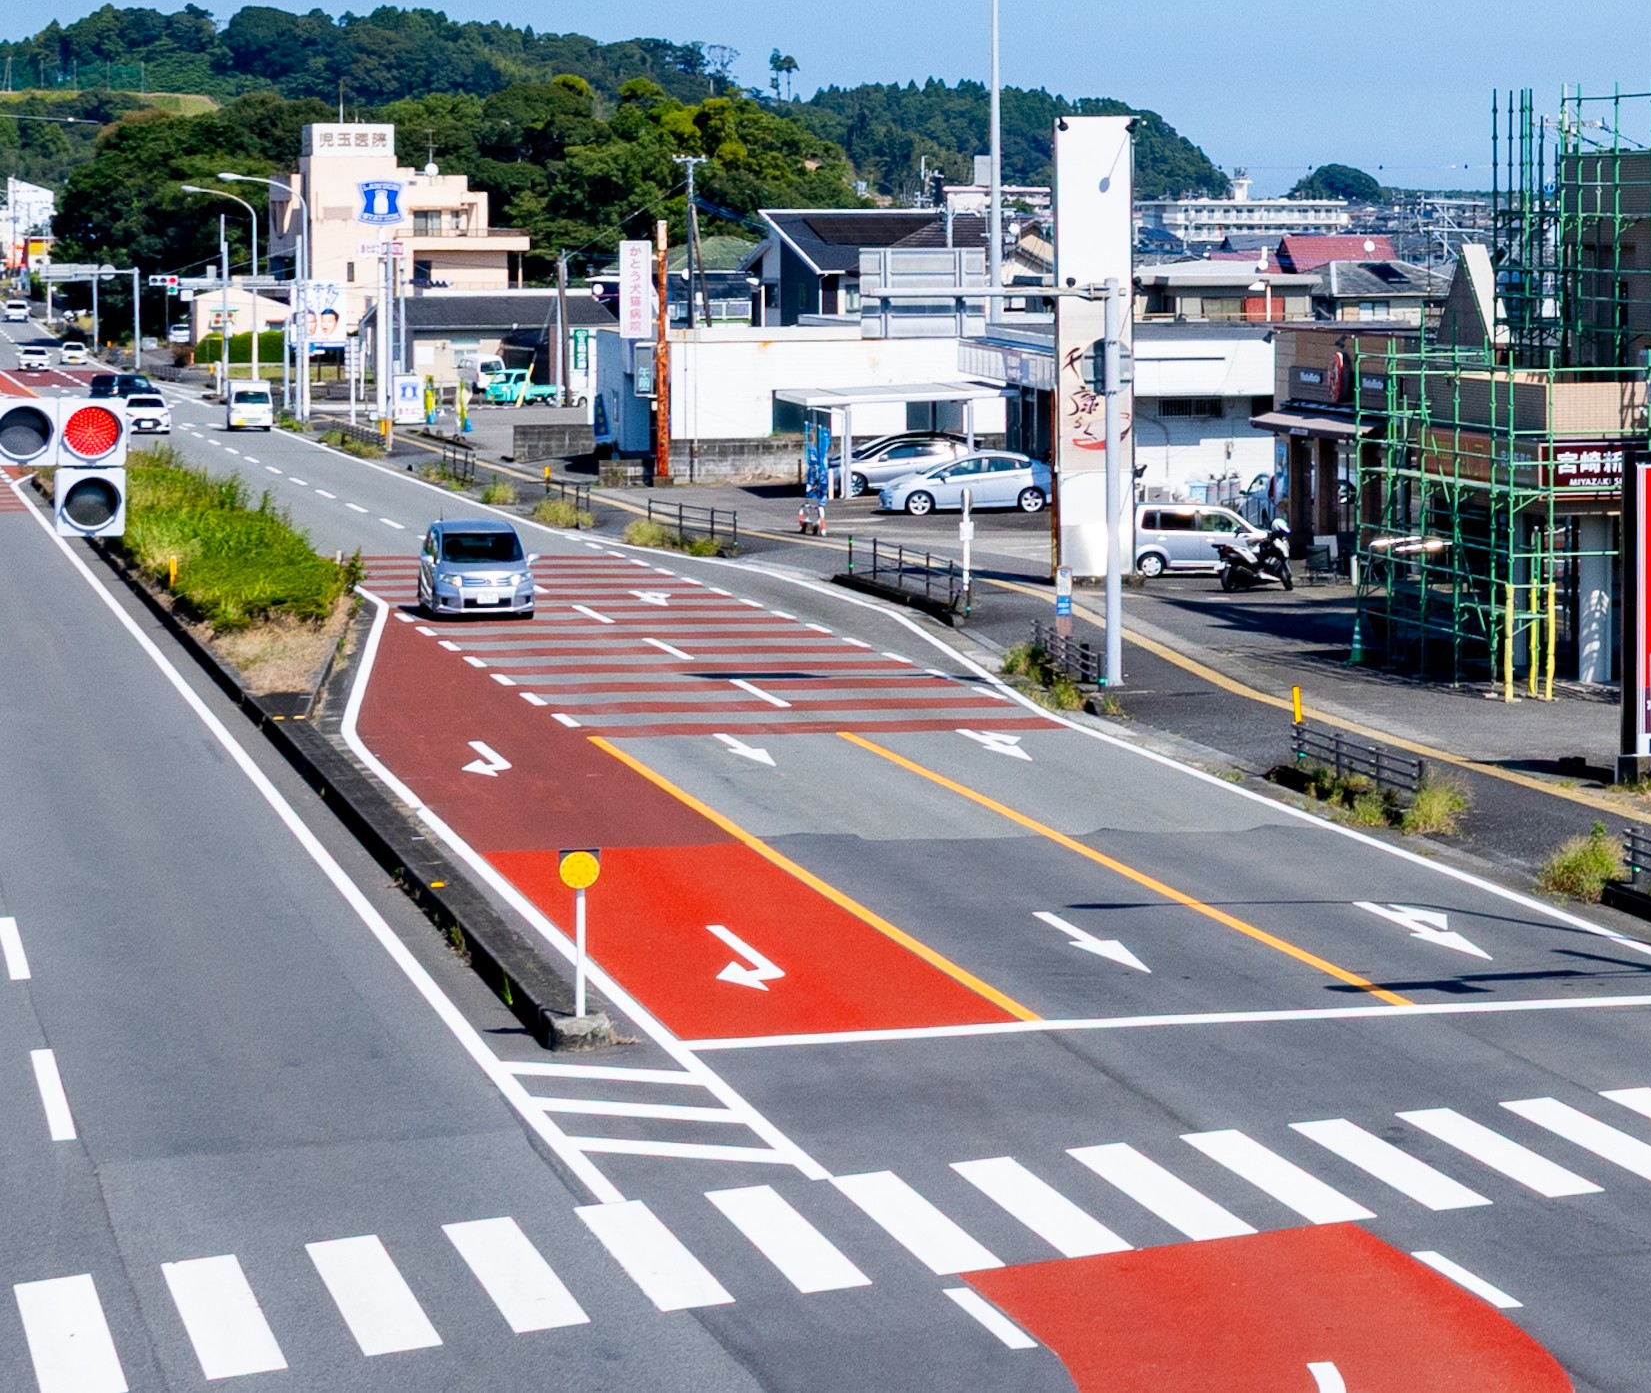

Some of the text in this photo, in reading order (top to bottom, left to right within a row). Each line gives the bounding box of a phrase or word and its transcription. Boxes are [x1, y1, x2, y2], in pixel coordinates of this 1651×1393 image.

[319, 132, 387, 148] 児玉医院
[1569, 477, 1611, 487] MIYAZAKI
